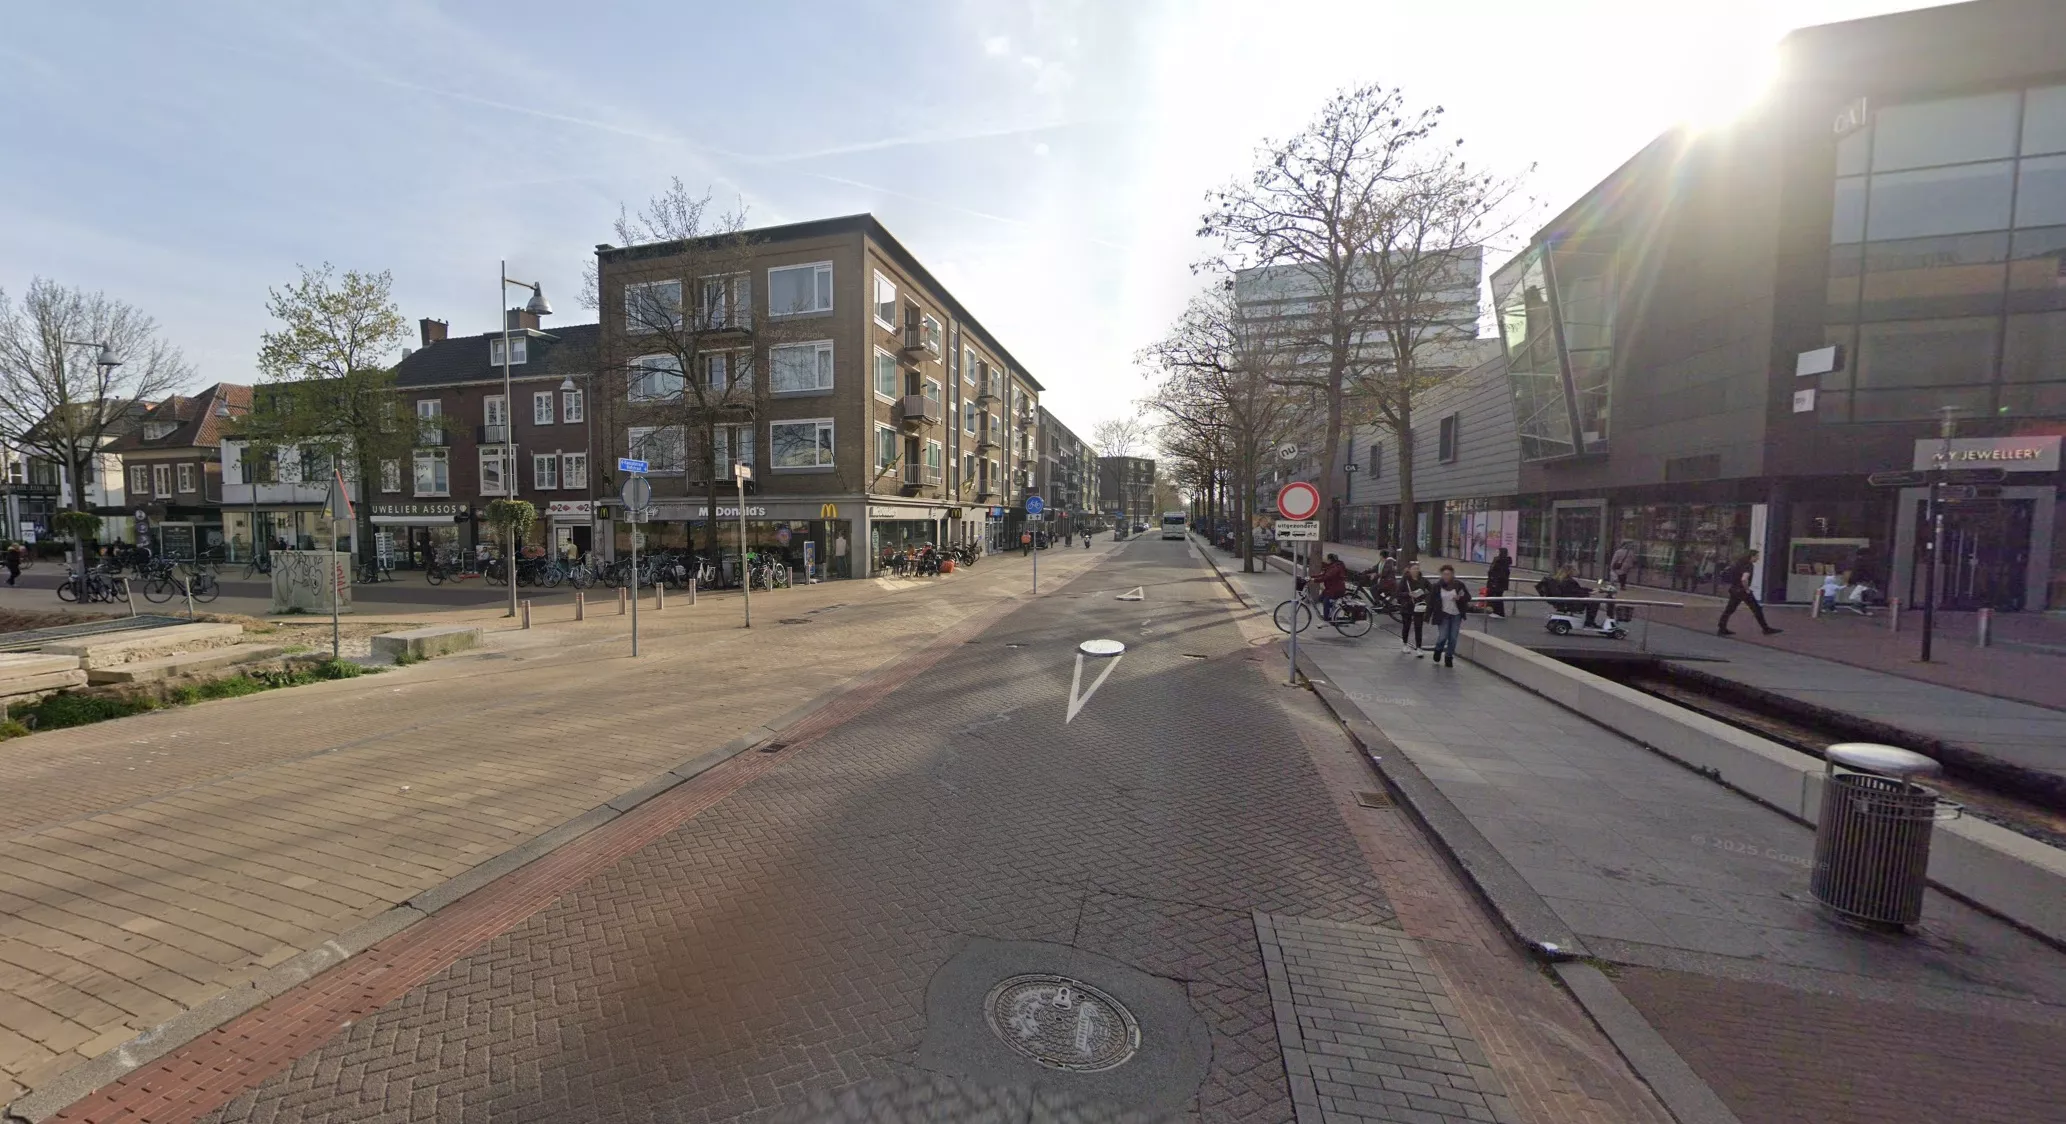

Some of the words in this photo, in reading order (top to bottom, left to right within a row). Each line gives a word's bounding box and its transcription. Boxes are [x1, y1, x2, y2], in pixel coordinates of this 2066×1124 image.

[1961, 448, 2042, 460] JEWELLERY
[372, 505, 418, 514] UWELIER
[423, 504, 457, 514] ASSOS
[699, 506, 766, 517] MDonld's
